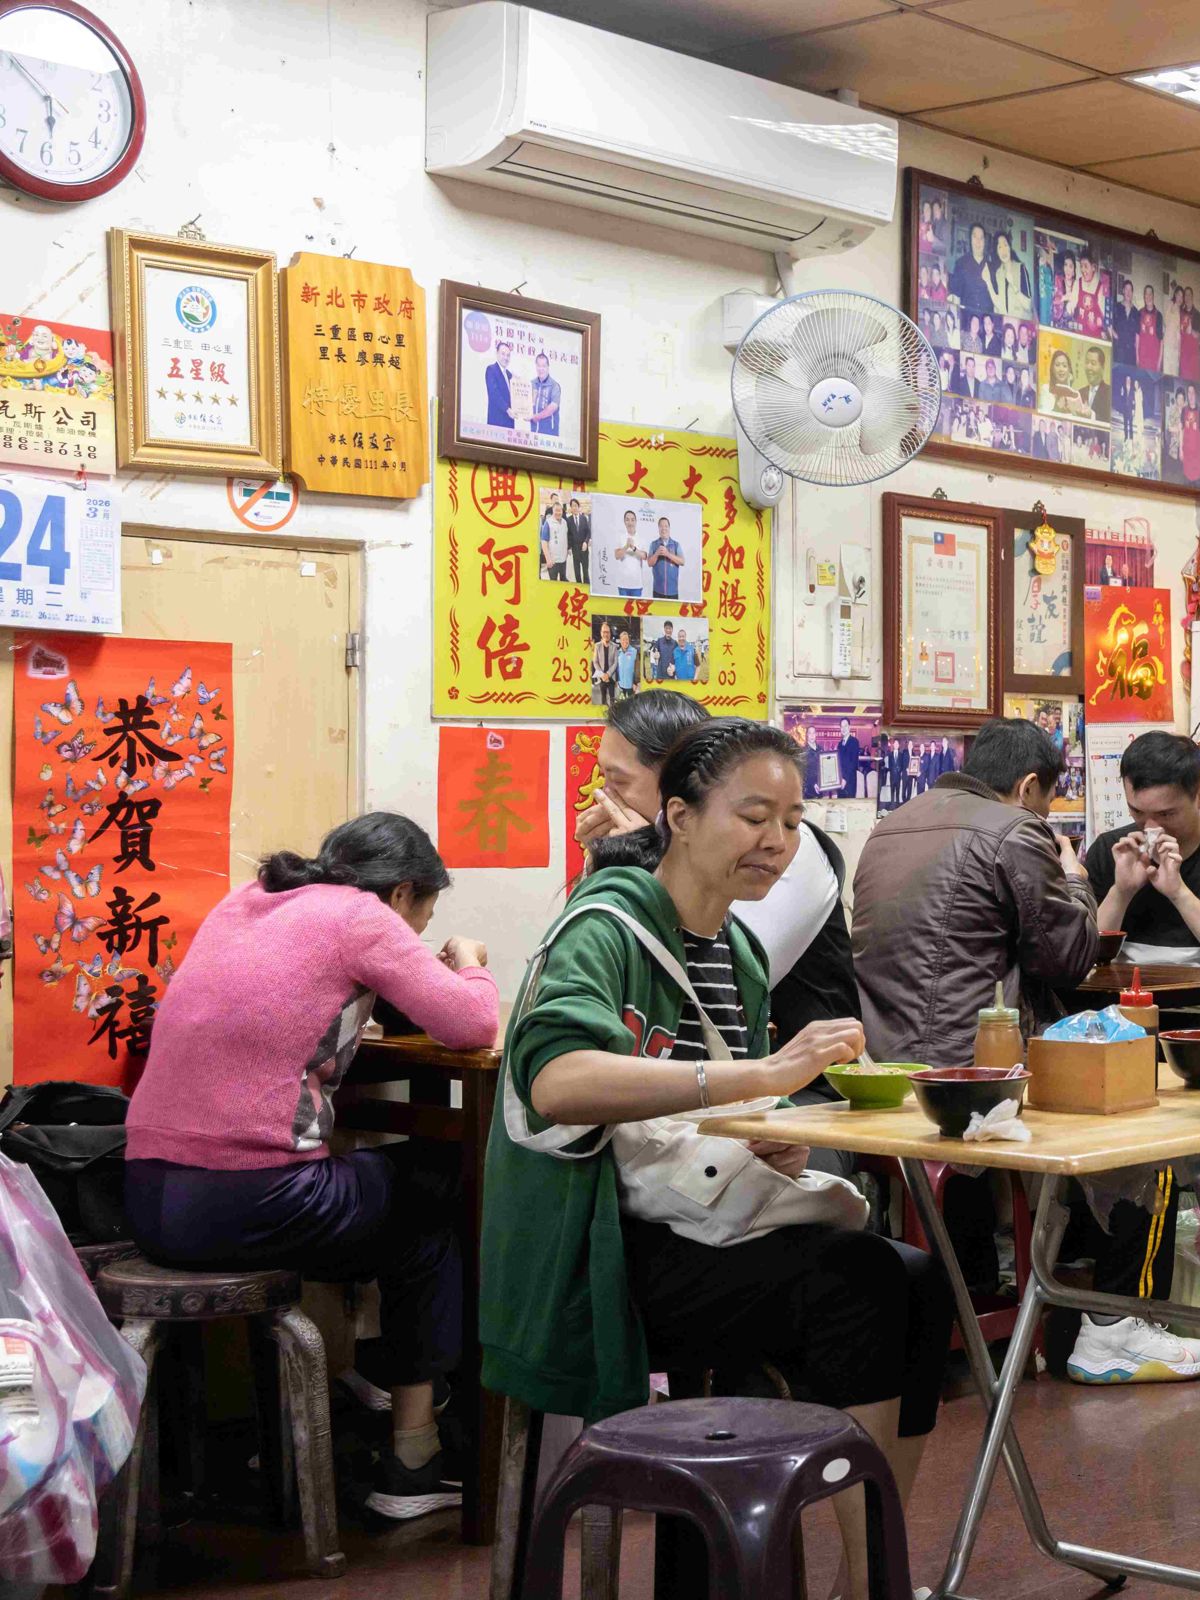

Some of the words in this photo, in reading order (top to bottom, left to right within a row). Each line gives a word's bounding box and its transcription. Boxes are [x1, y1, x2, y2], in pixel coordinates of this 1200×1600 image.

[98, 101, 111, 123] 3
[16, 128, 28, 153] 7
[88, 127, 101, 149] 4
[40, 141, 53, 166] 6
[68, 141, 81, 165] 5
[300, 283, 415, 319] 新北市政府
[161, 337, 193, 350] 三重區
[200, 343, 232, 354] 田心里
[314, 324, 405, 347] 三重區田心里
[319, 346, 347, 363] 里長
[356, 350, 401, 370] 廖興超
[167, 357, 229, 385] 五星級
[302, 378, 418, 423] 特優里長
[0, 400, 96, 431] 瓦斯公司
[3, 434, 96, 453] 86-9710
[3, 441, 96, 459] 86-8036
[328, 433, 347, 445] 市長
[353, 432, 395, 451] 侯友宜
[317, 454, 407, 472] 中華民國111年9月
[625, 459, 655, 499] 大
[681, 464, 709, 504] 大
[86, 499, 111, 507] 2026
[0, 587, 63, 607] 期二
[11, 609, 20, 618] 25
[38, 611, 47, 620] 26
[65, 614, 74, 622] 27
[557, 635, 569, 650] 小
[722, 642, 733, 656] 大
[552, 657, 573, 683] 25
[458, 751, 534, 854] 春
[88, 695, 183, 1061] 恭賀新禧
